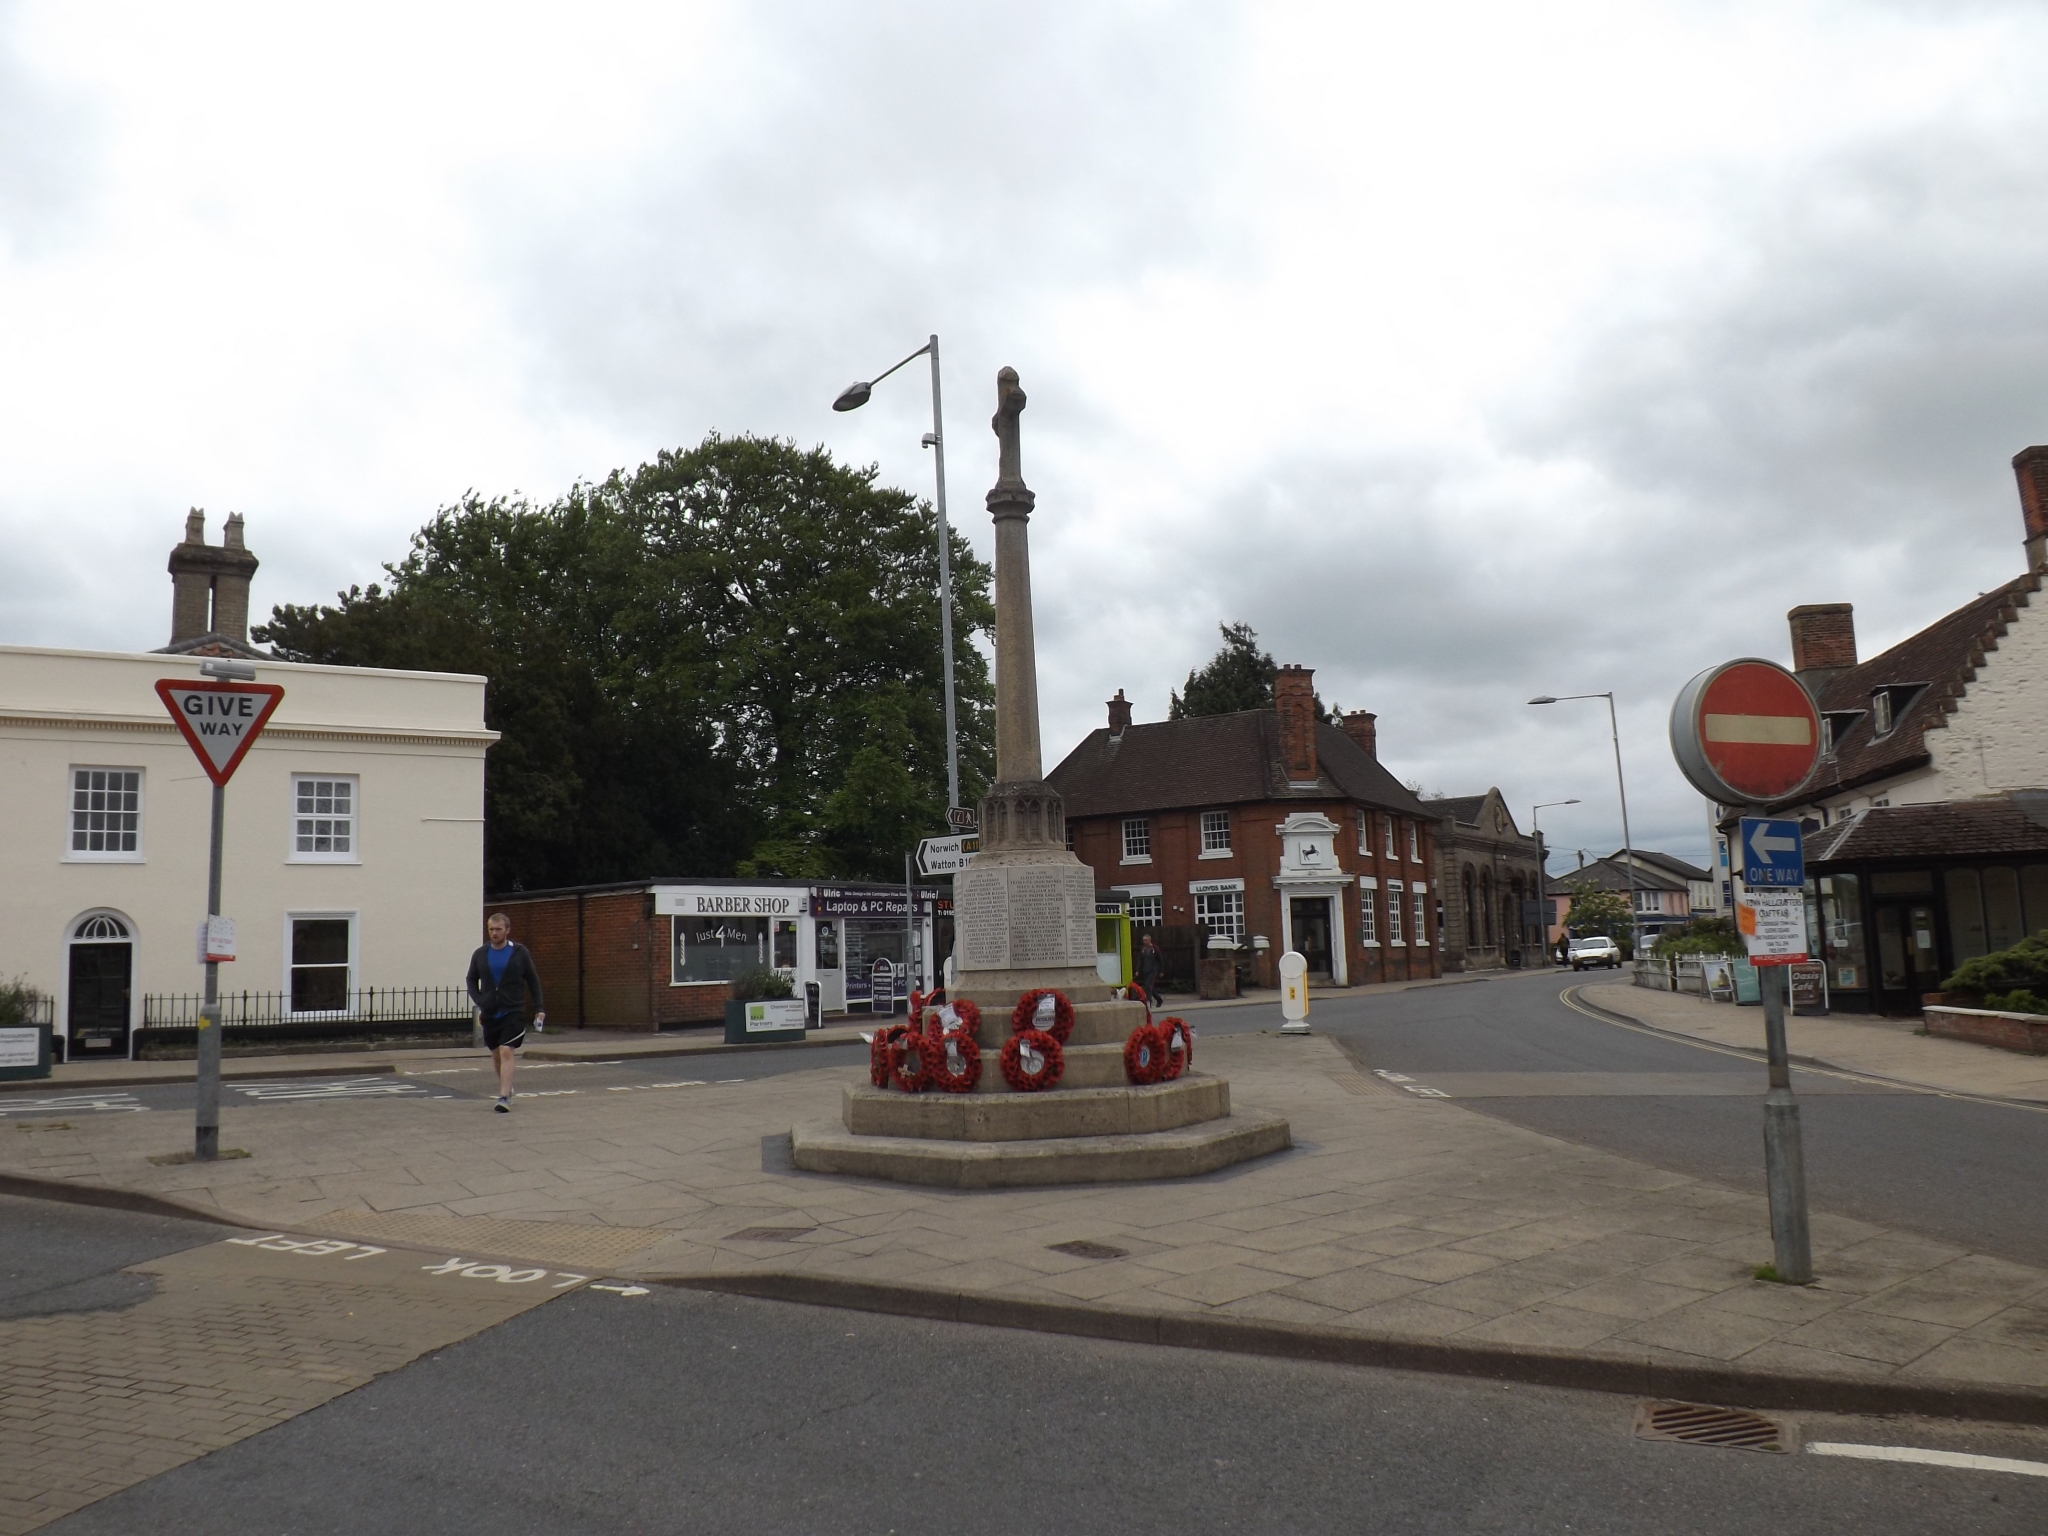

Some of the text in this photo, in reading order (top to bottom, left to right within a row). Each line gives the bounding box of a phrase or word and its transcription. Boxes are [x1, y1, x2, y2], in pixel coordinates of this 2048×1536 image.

[184, 694, 254, 717] GIVE
[200, 722, 242, 736] WAY
[930, 843, 958, 853] Norwich
[931, 860, 956, 870] Watton
[1750, 868, 1798, 882] ONE WAY
[824, 888, 840, 898] Ulric
[697, 896, 789, 913] BARBER SHOP
[826, 901, 918, 914] Laptop & PC Repas
[696, 925, 747, 948] Just 4 Men
[1792, 972, 1819, 980] Oasis
[846, 981, 868, 989] Printers
[1792, 982, 1814, 990] Café
[227, 1234, 588, 1288] LOOK LEFT
